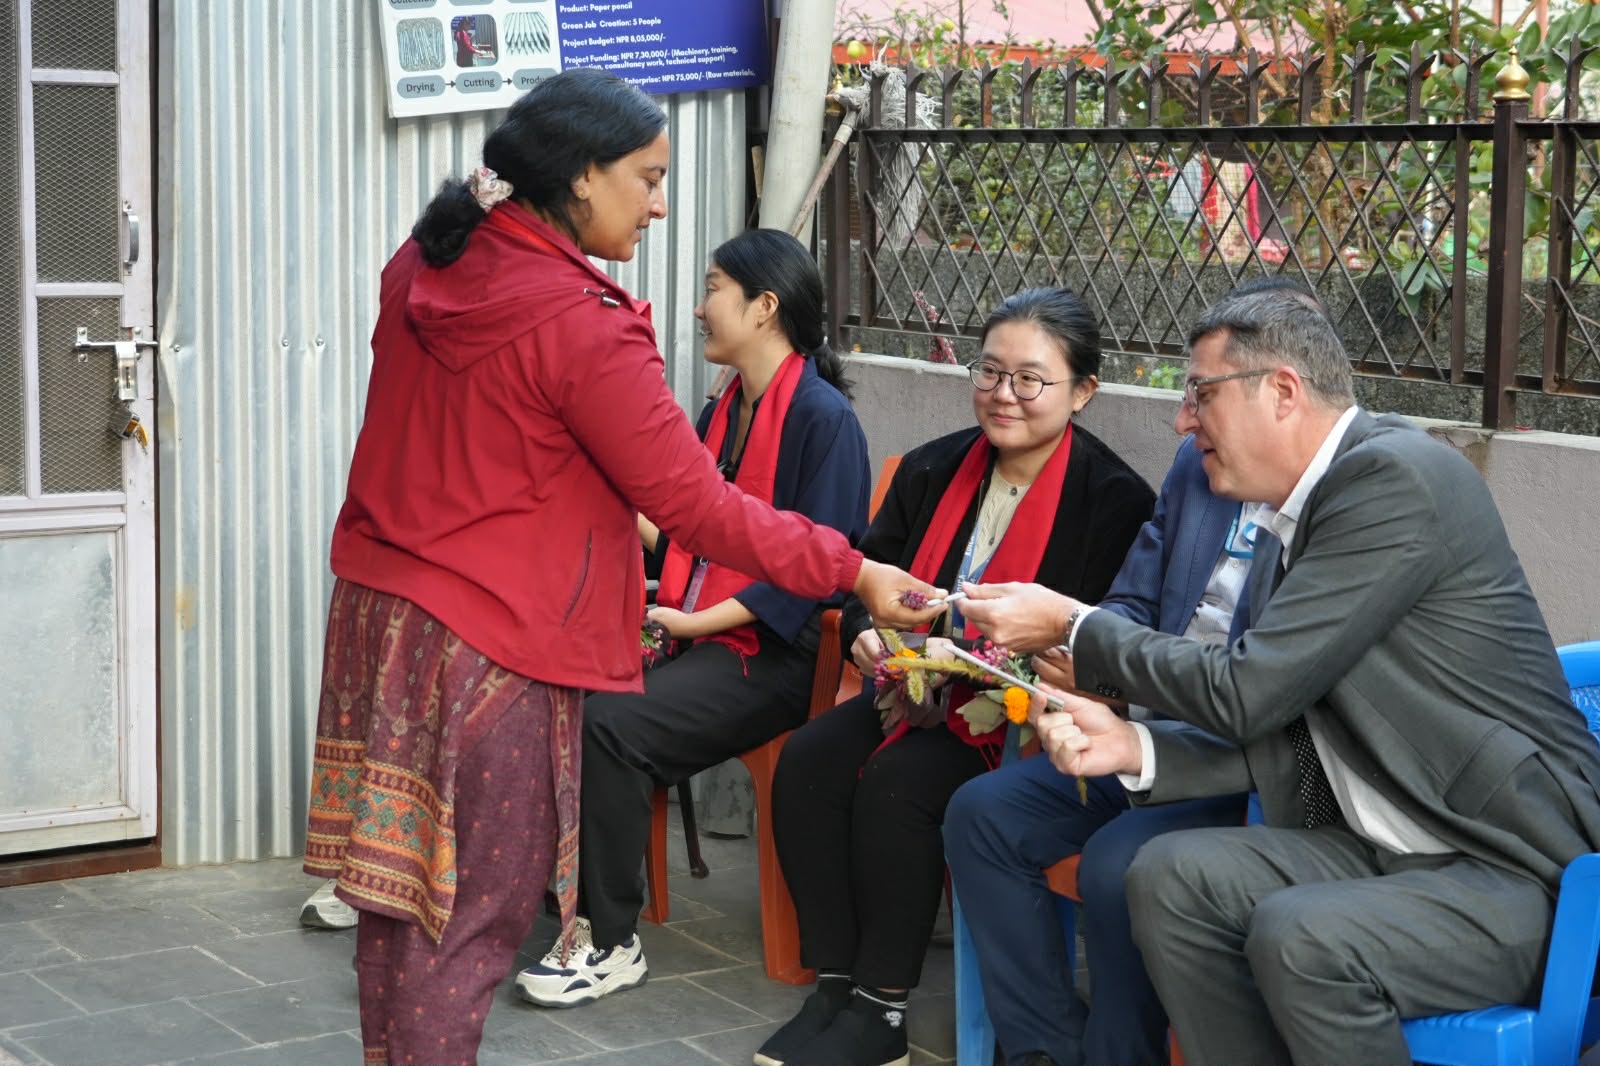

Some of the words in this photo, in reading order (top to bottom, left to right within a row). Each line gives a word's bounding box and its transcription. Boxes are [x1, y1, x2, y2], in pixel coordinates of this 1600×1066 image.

[560, 5, 589, 13] Product:
[590, 3, 610, 12] Paper
[611, 1, 633, 12] pencil
[561, 22, 583, 30] Green
[584, 21, 597, 29] Job
[599, 19, 631, 28] Creation:
[638, 17, 661, 26] People
[563, 39, 587, 48] Project
[588, 37, 615, 46] Budget:
[630, 33, 666, 43] 8,05,000/-
[565, 56, 588, 66] Project
[590, 54, 620, 62] Funding:
[605, 60, 645, 69] consultancy
[666, 56, 697, 65] technical
[463, 77, 496, 88] Cutting
[662, 74, 675, 82] NPR
[406, 82, 435, 93] Drying
